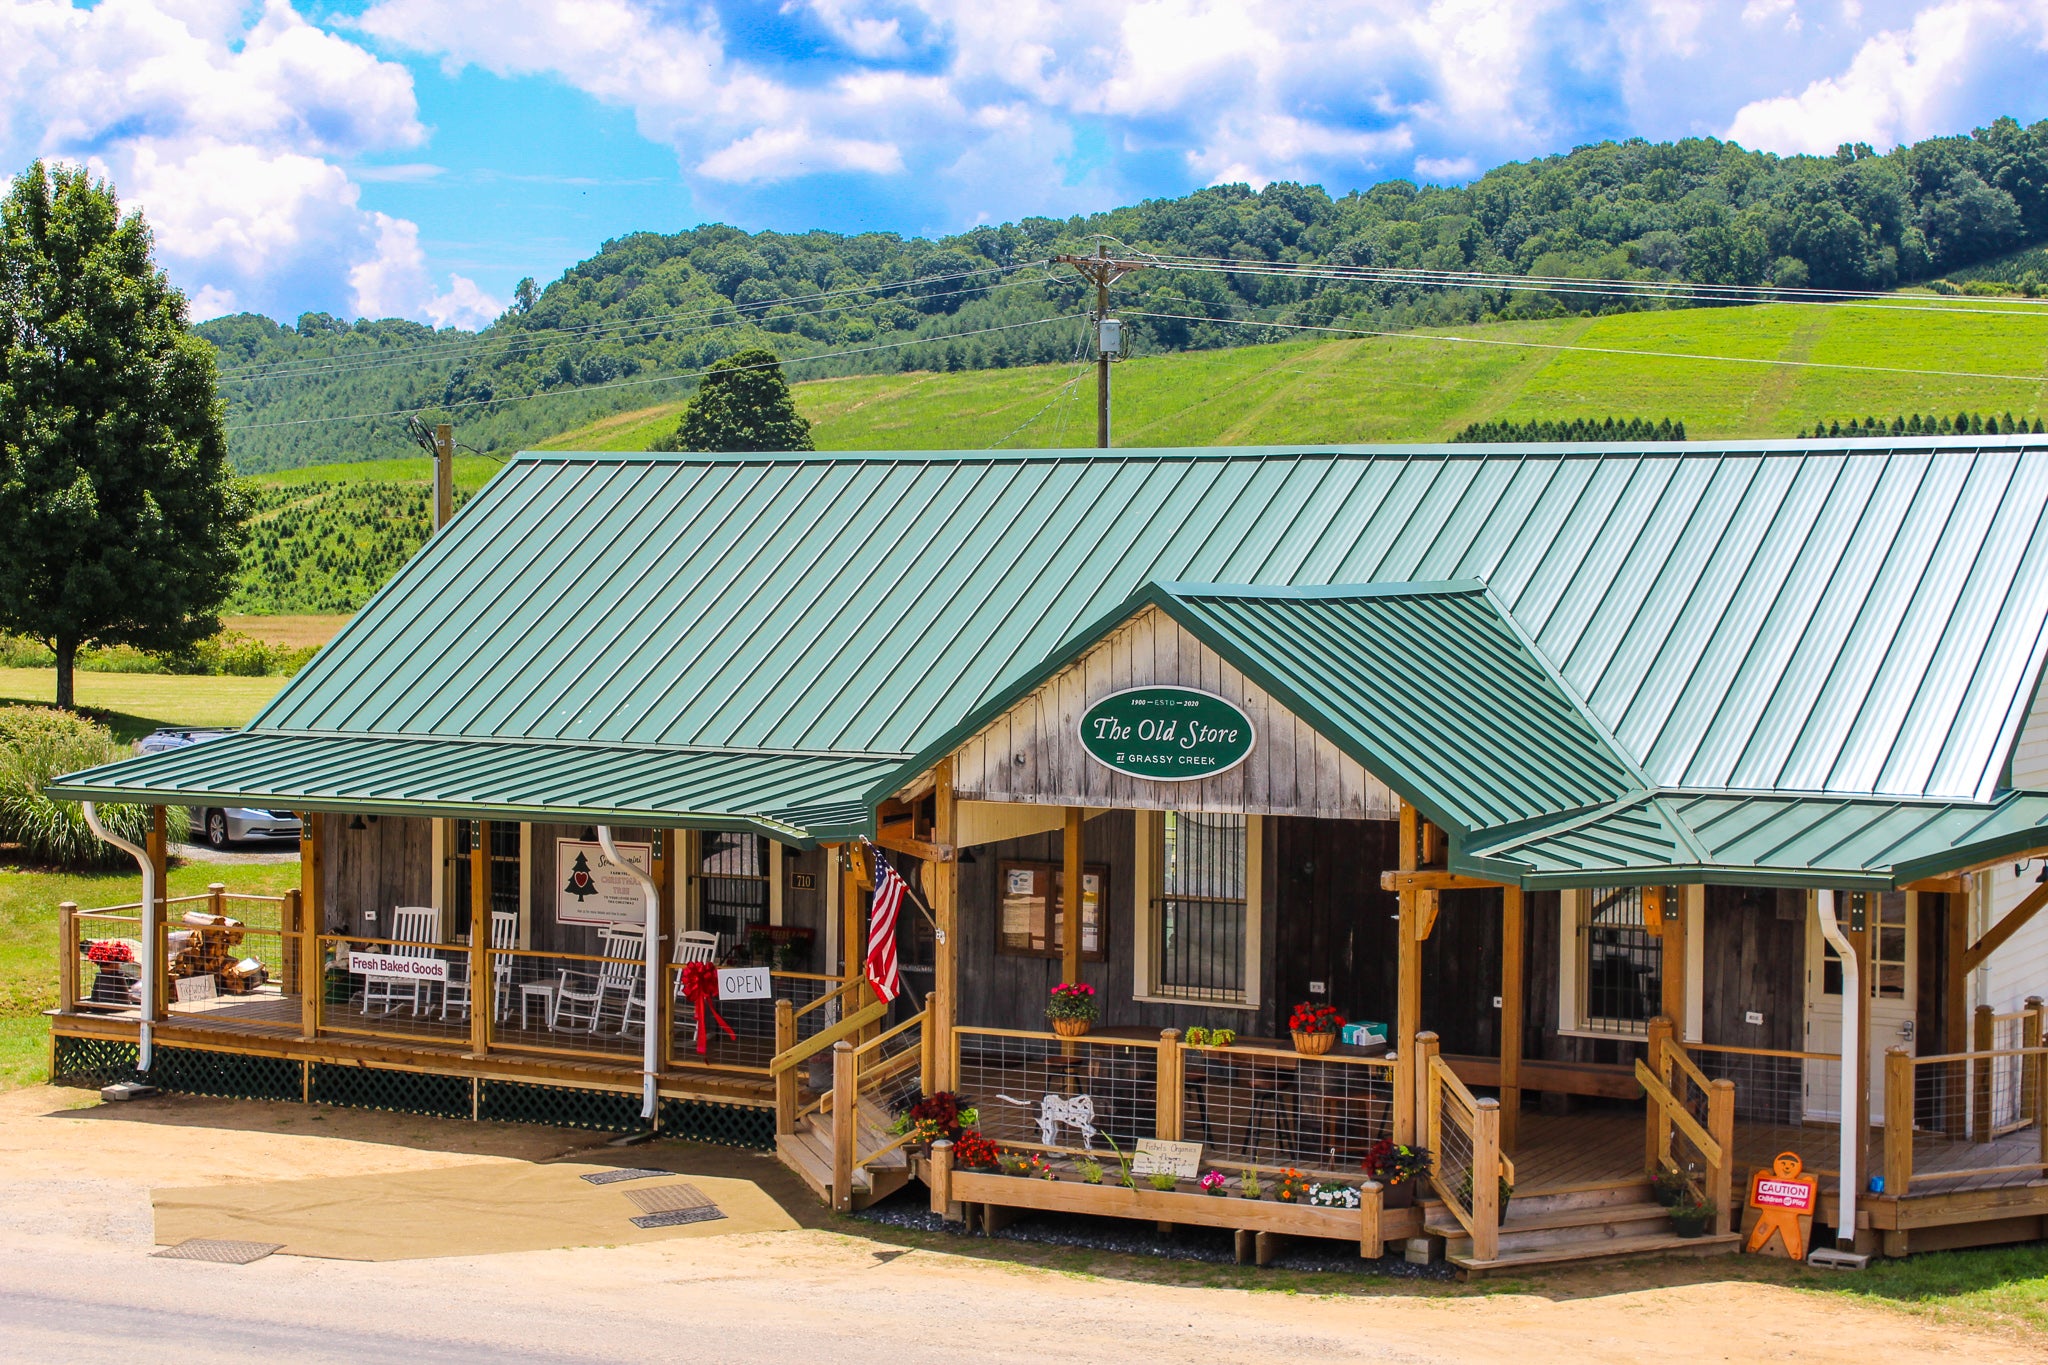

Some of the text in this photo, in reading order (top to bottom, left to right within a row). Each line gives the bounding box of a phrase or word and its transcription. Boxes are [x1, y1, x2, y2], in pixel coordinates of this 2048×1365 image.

[1093, 716, 1238, 749] The Old Store
[1128, 754, 1173, 763] GRASSY
[1178, 756, 1216, 765] CREEK
[796, 875, 811, 888] 710
[353, 957, 443, 976] Fresh Baked Goods
[725, 974, 763, 993] OPEN
[1761, 1183, 1806, 1196] CAUTION
[1758, 1195, 1783, 1203] Children
[1792, 1199, 1807, 1208] Play
